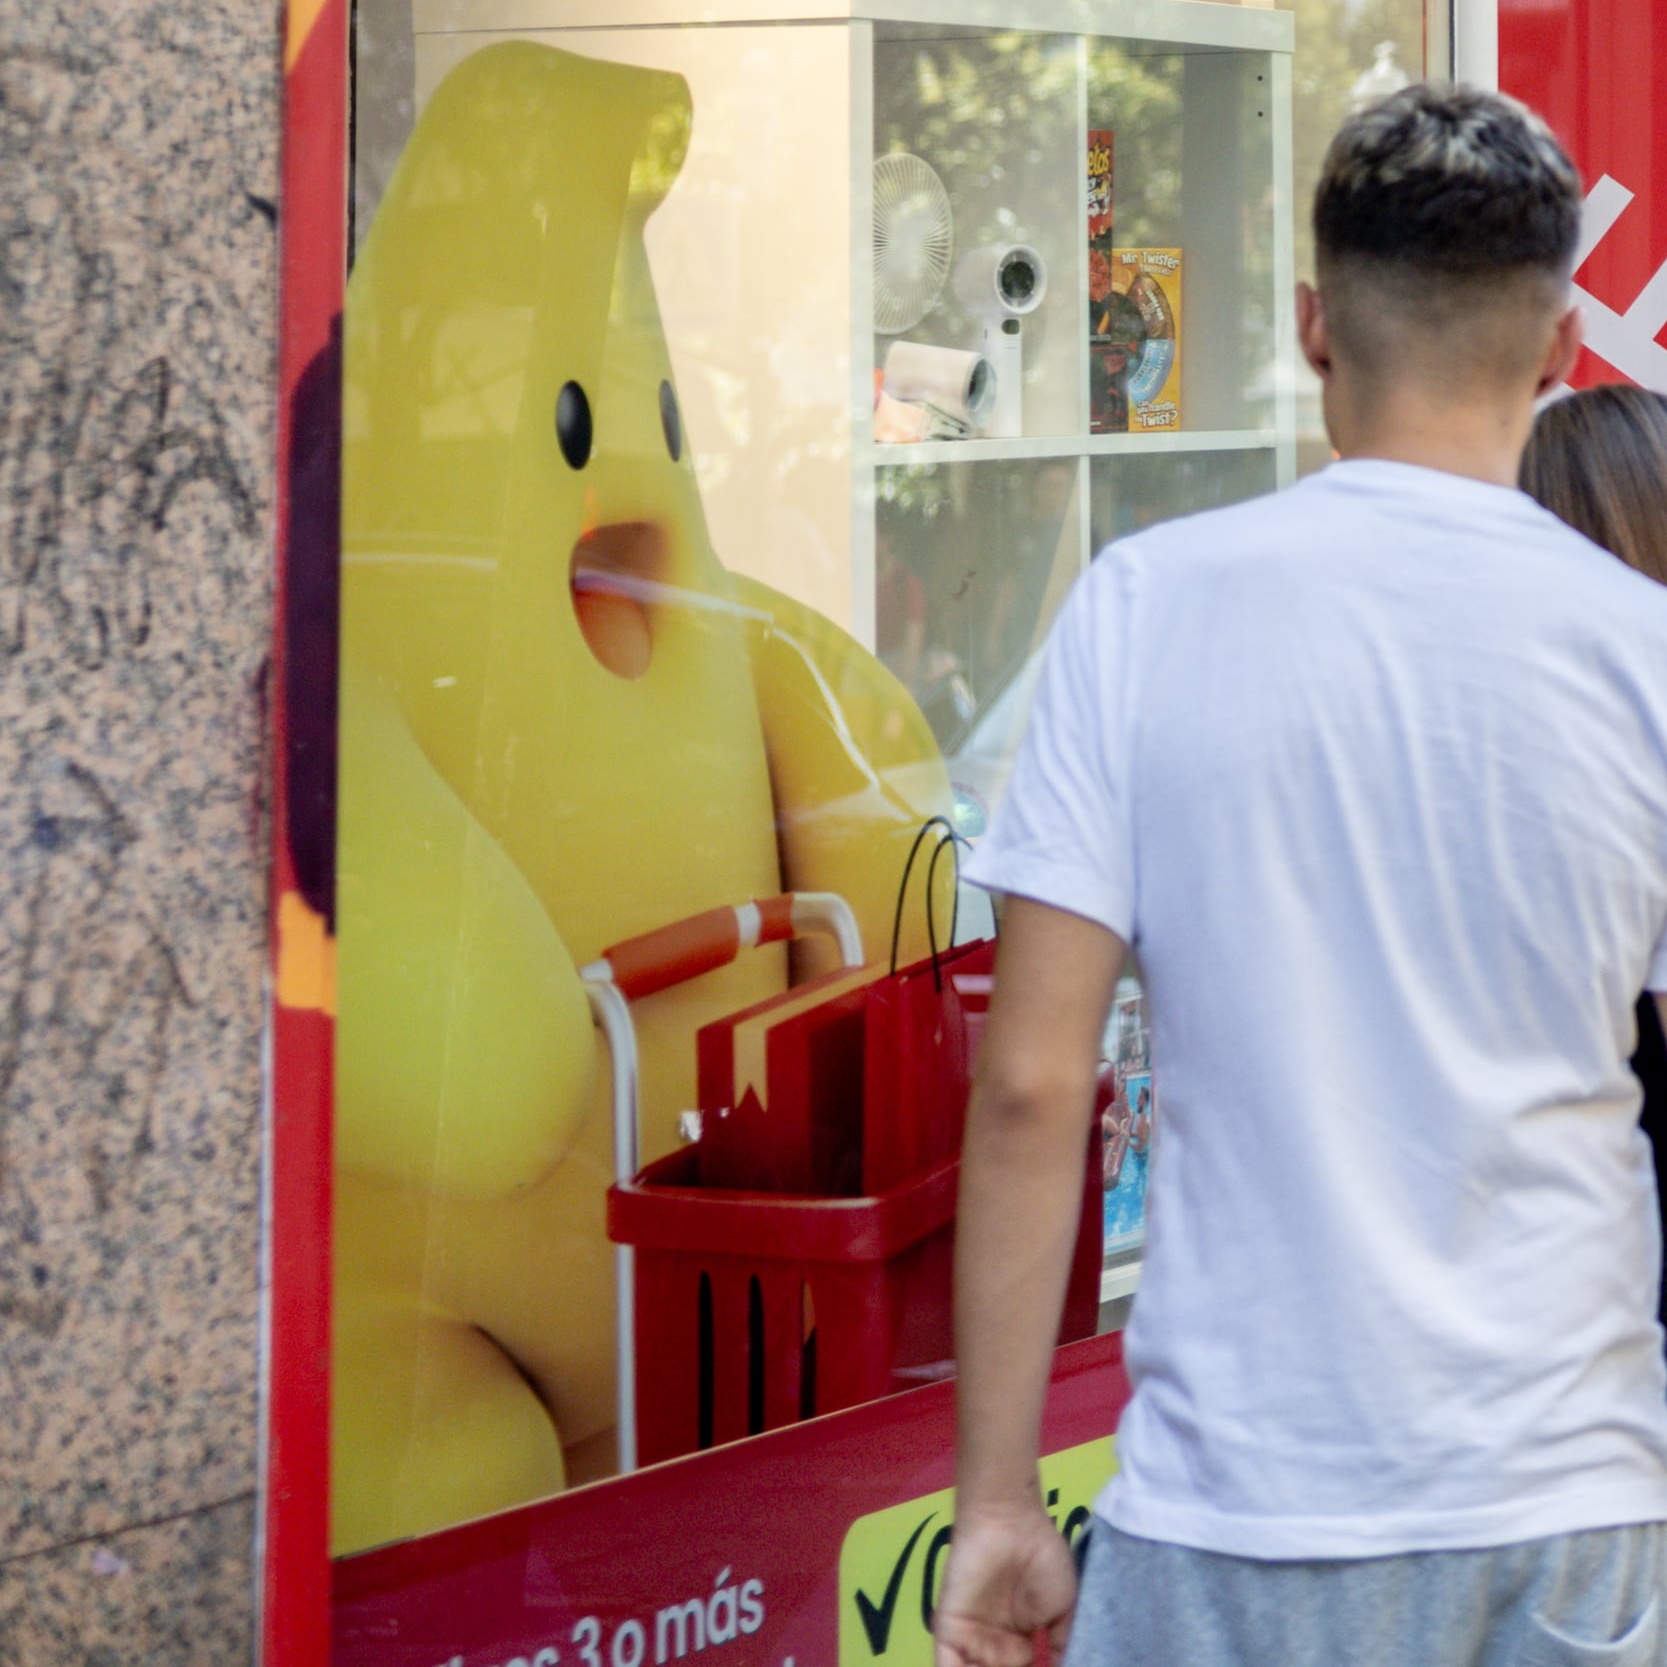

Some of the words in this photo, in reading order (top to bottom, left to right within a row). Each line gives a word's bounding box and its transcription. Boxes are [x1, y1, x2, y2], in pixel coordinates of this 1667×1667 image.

[1142, 250, 1180, 270] Twister
[1142, 410, 1178, 428] Twist?
[611, 1619, 646, 1667] o
[654, 1564, 766, 1666] más
